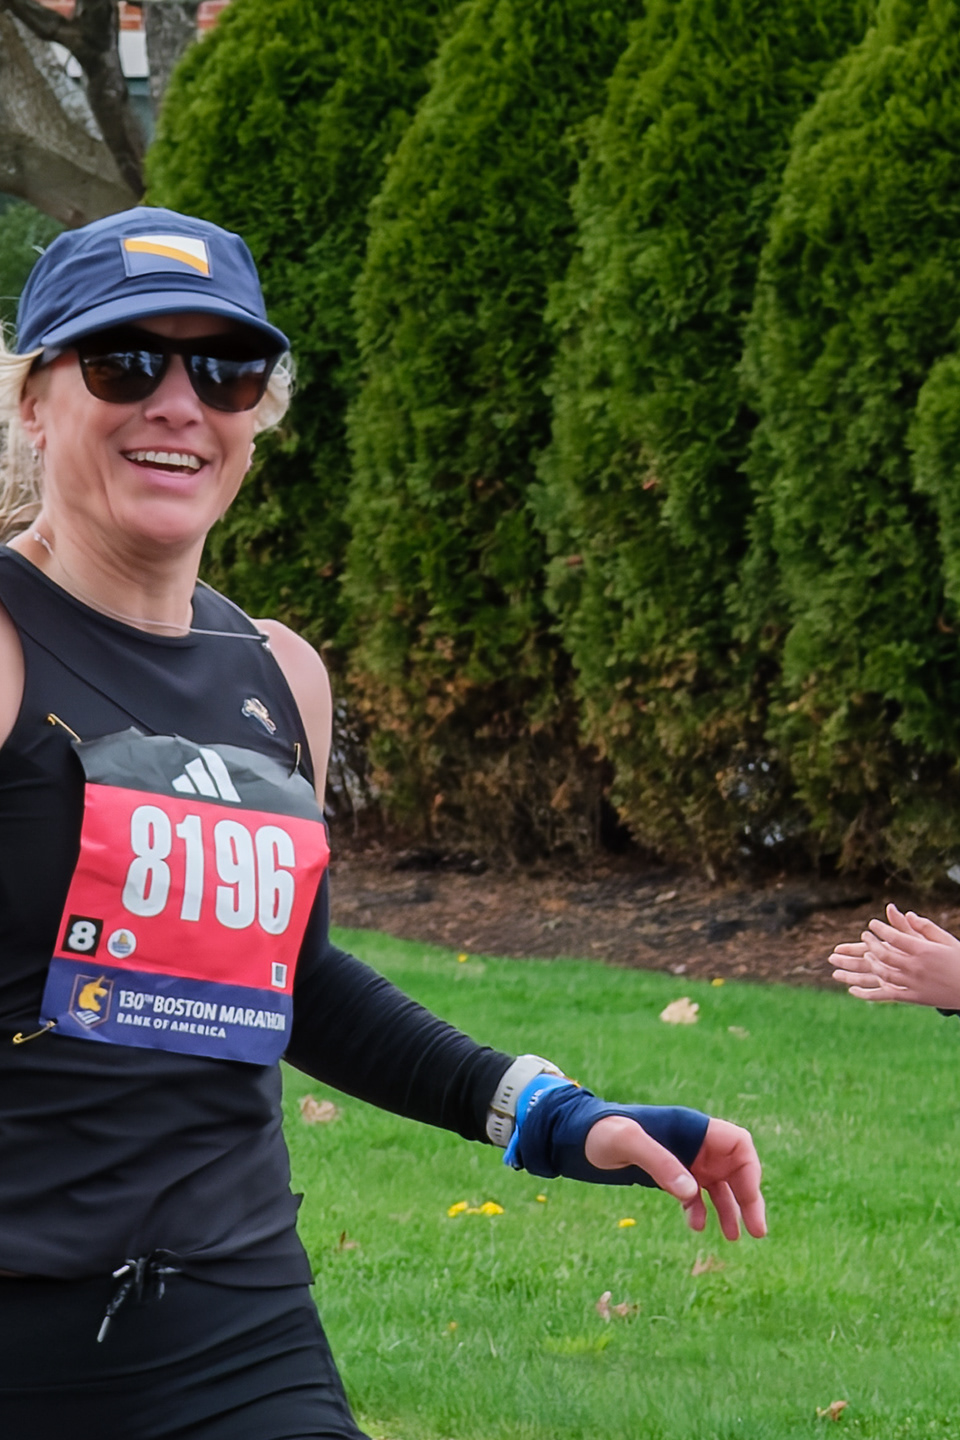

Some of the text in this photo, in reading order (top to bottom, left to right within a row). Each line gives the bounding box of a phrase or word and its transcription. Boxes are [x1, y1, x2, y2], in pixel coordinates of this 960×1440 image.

[122, 805, 296, 935] 8196
[68, 920, 96, 951] 8
[116, 1012, 226, 1039] BANK OF AMERICA
[153, 996, 217, 1021] BOSTON
[219, 1005, 286, 1031] MARATHON
